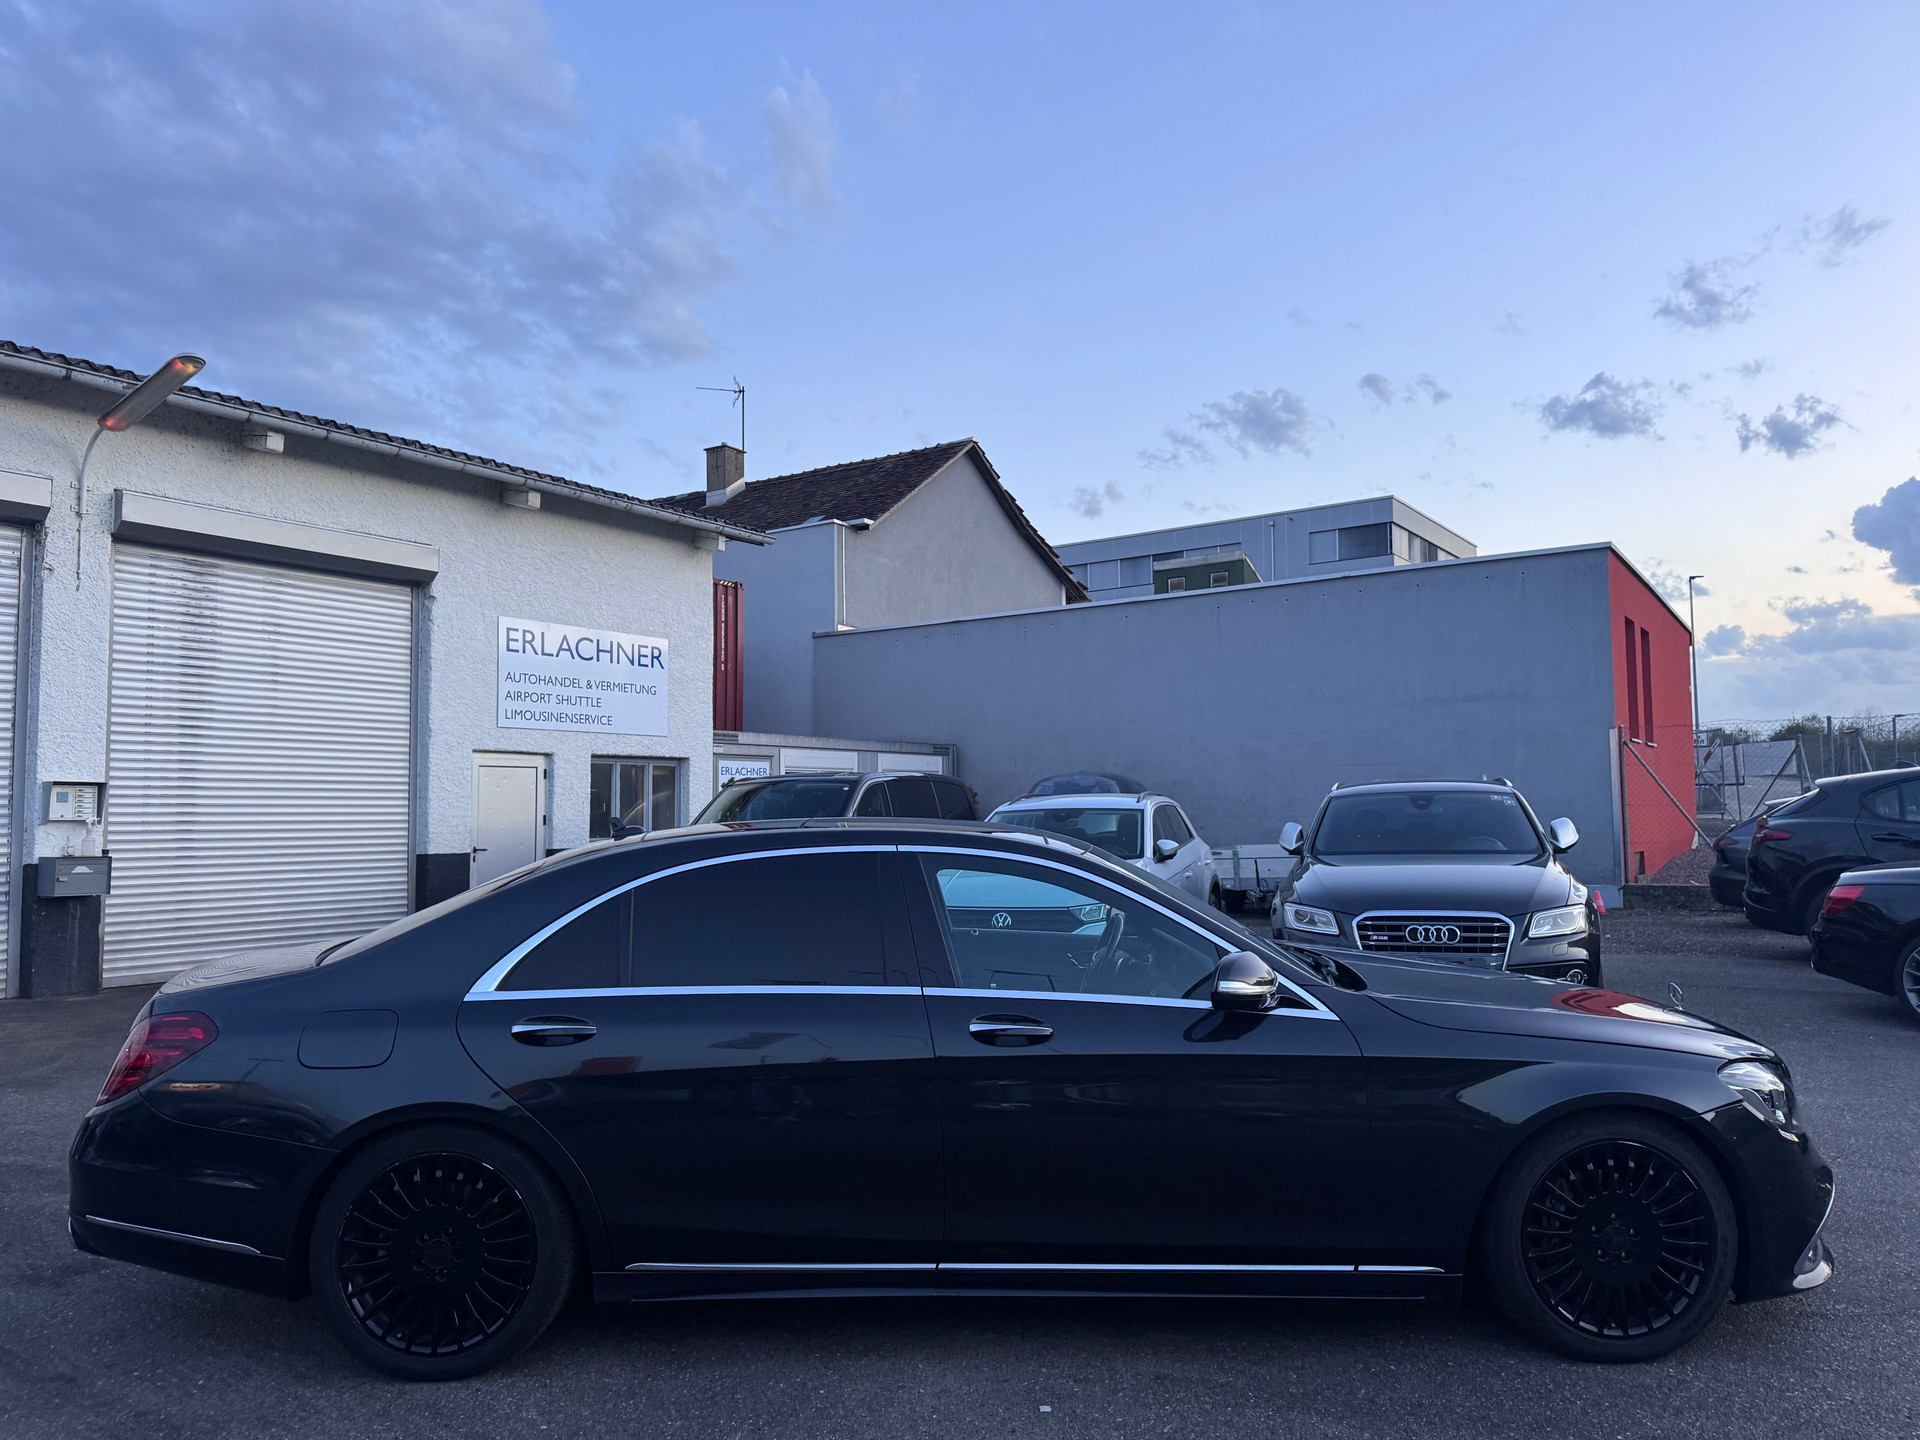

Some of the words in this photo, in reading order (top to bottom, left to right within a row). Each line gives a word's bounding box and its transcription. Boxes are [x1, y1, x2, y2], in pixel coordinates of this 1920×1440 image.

[505, 626, 665, 670] ERLACHNER
[504, 671, 584, 689] AUTOHANDEL
[585, 679, 593, 690] &
[594, 680, 657, 696] VERMIETUNG
[504, 690, 553, 704] AIRPORT
[555, 694, 602, 708] SHUTTLE
[504, 708, 613, 726] LIMOUSINENSERVICE
[720, 766, 768, 776] ERLACHNER
